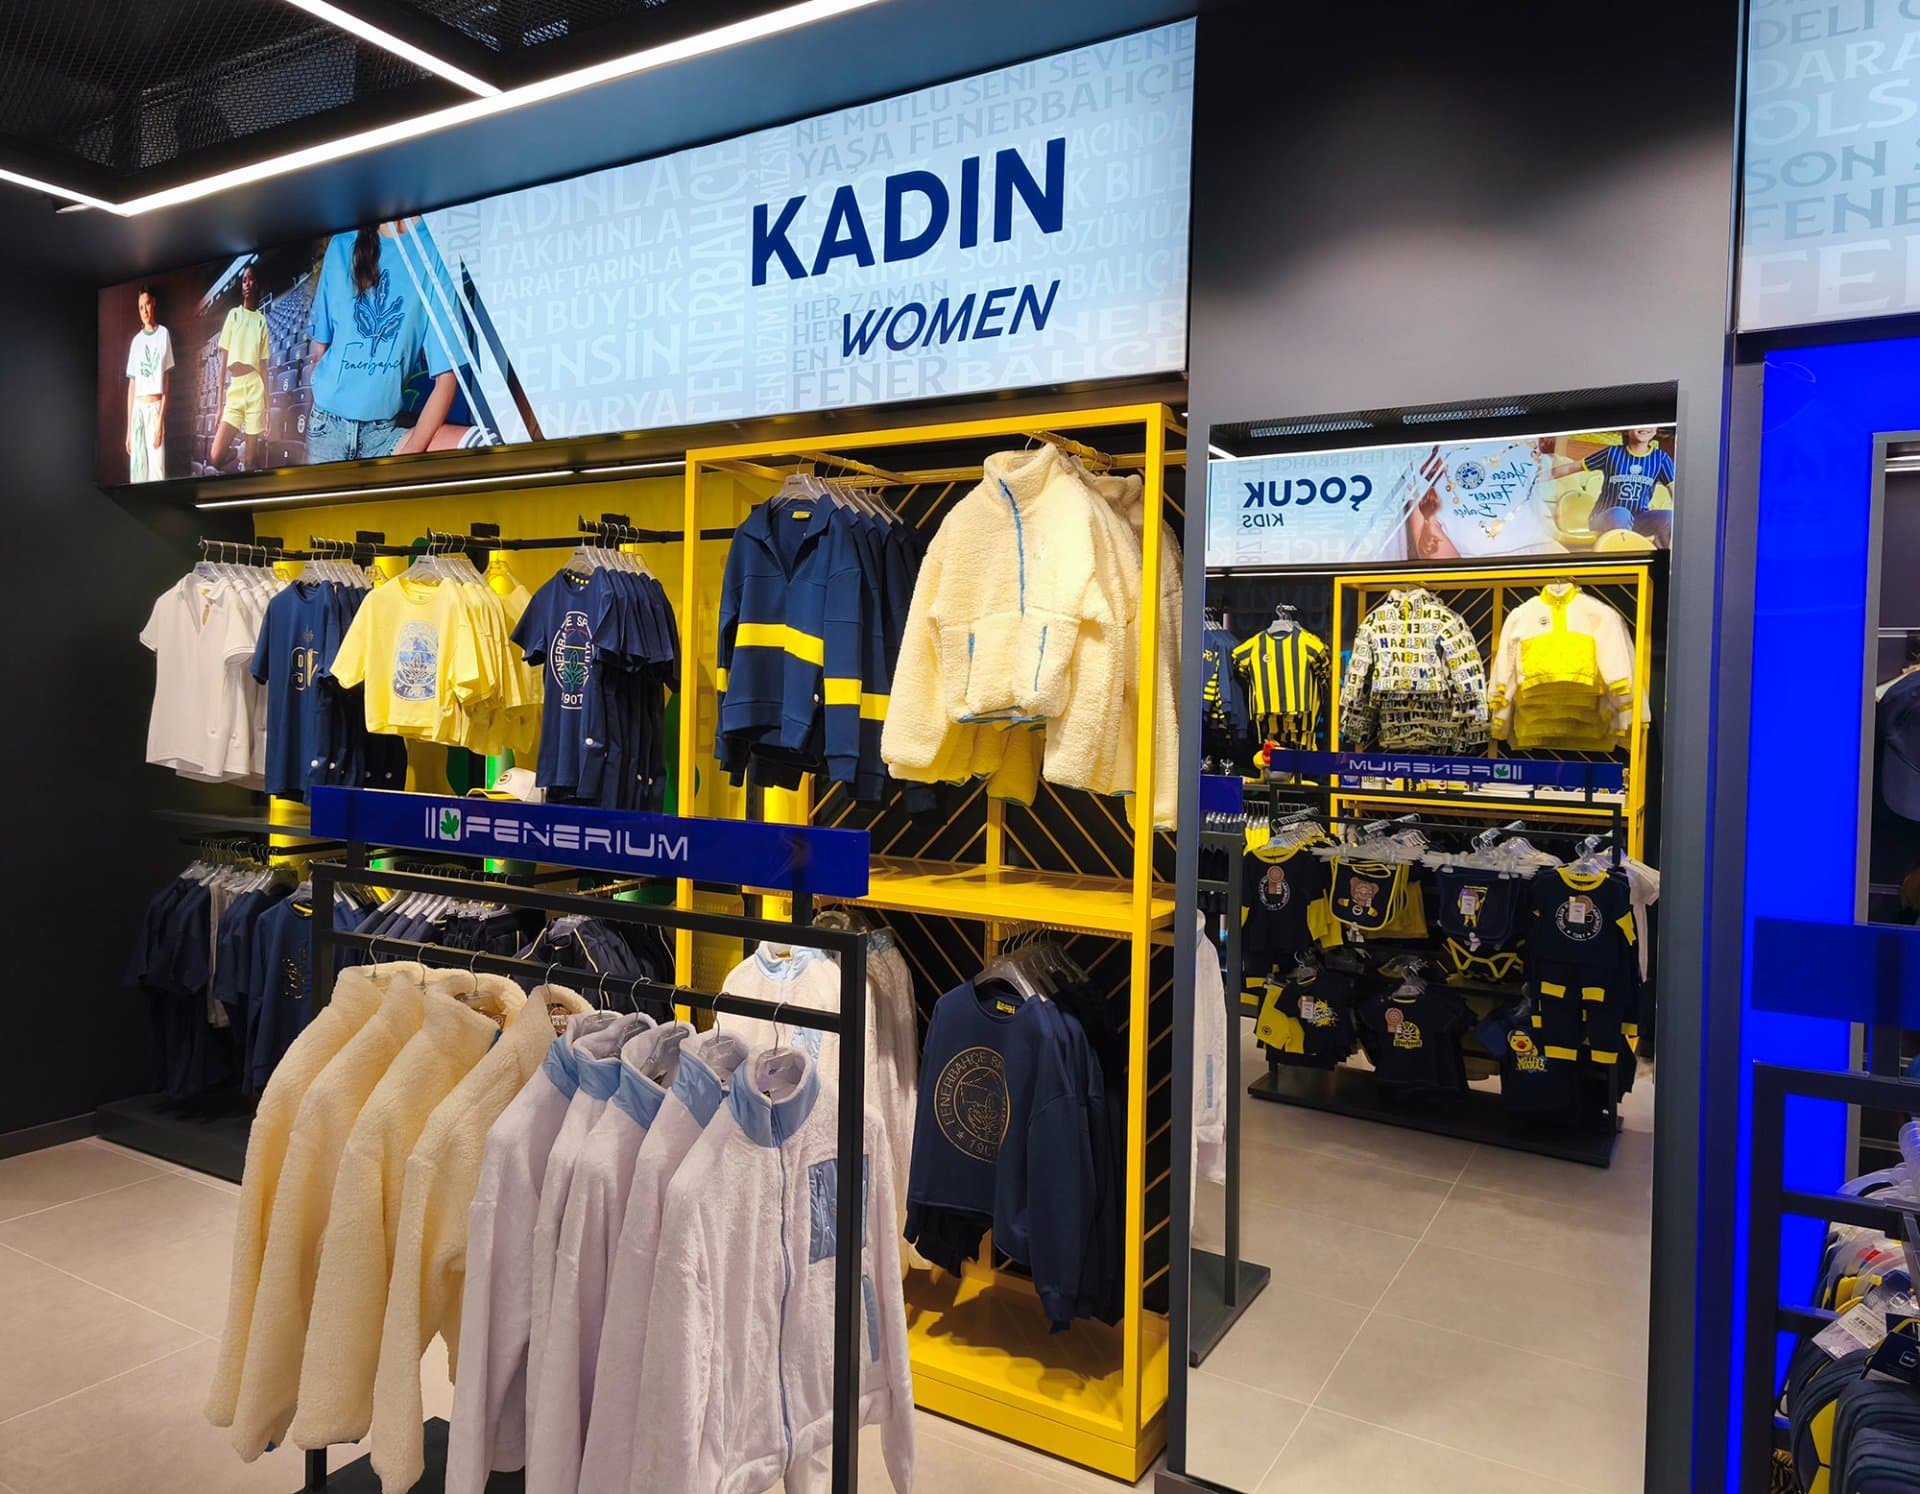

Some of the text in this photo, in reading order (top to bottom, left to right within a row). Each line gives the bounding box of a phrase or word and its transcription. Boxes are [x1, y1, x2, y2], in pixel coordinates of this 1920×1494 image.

[794, 116, 832, 147] NE
[796, 56, 1193, 177] YAŞA FENERBAHÇE
[1746, 139, 1889, 196] SON
[751, 137, 1066, 287] KADIN
[488, 207, 684, 277] TAKIMINLA
[488, 247, 685, 304] TARAFTARINLA
[687, 140, 757, 421] FENERBAHÇE
[793, 296, 841, 324] HER
[849, 279, 949, 314] ZAMAN
[546, 278, 685, 335] BÜYÜK
[842, 280, 1061, 358] WOMEN
[791, 355, 947, 410] FENER
[463, 814, 689, 862] FENERIUM
